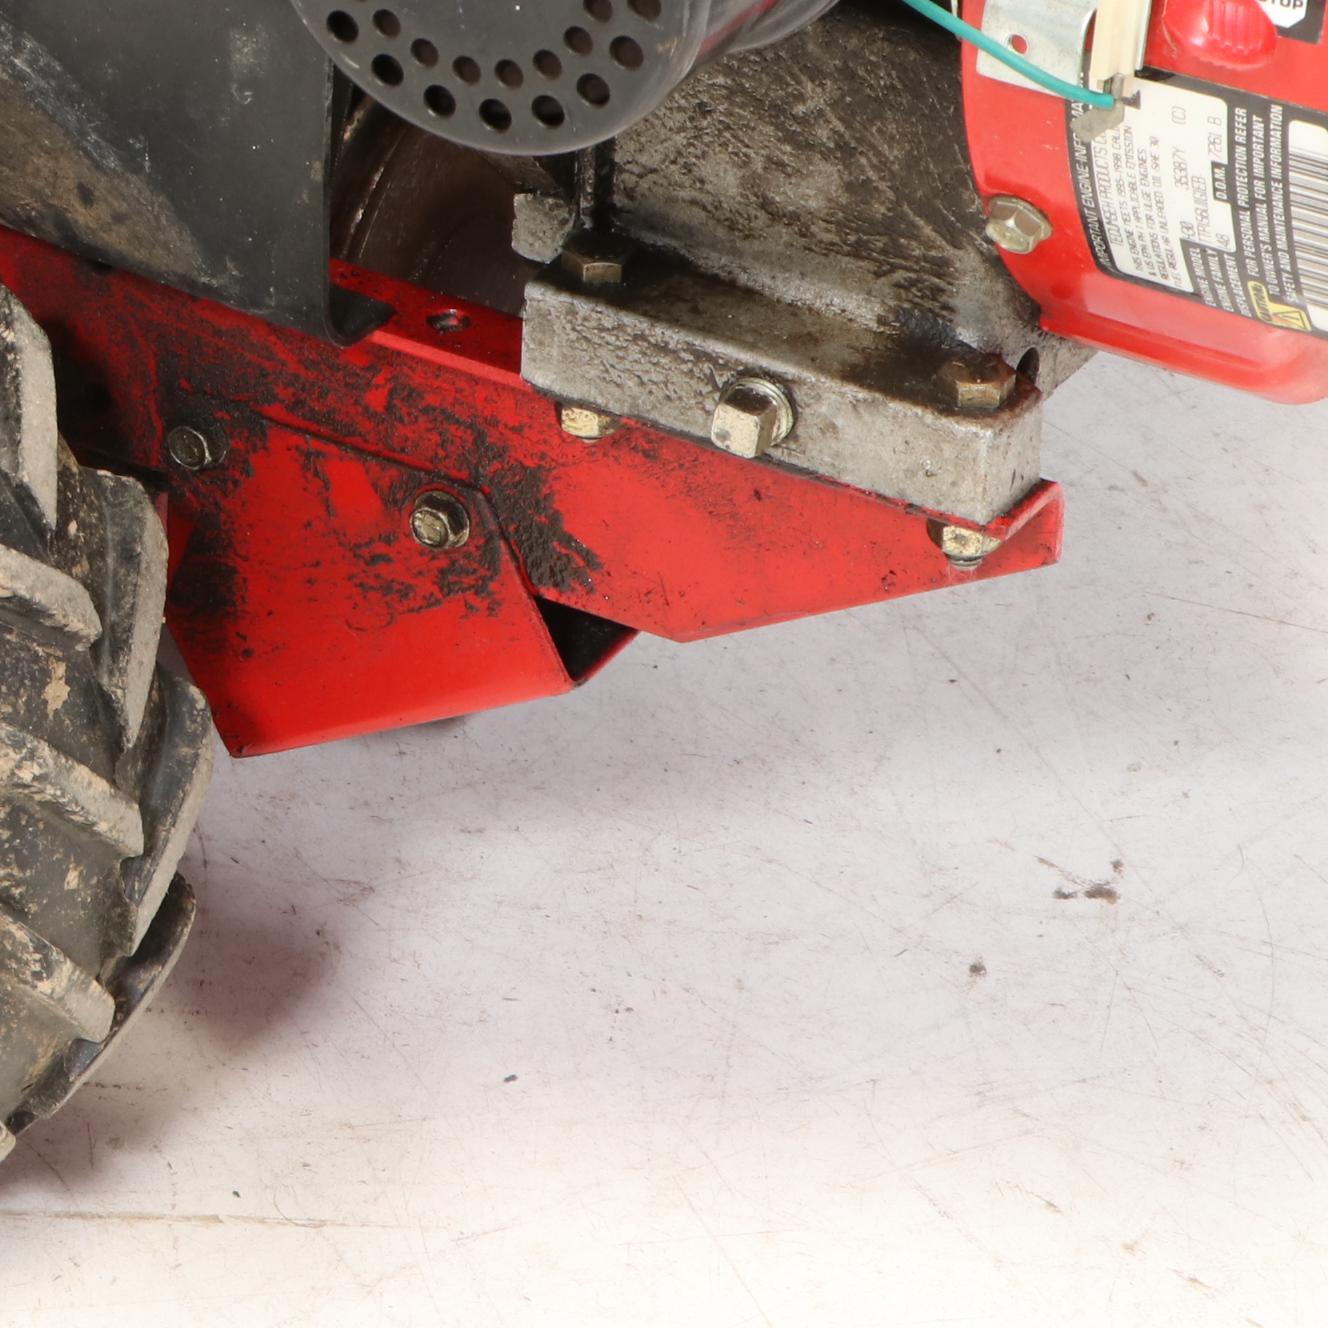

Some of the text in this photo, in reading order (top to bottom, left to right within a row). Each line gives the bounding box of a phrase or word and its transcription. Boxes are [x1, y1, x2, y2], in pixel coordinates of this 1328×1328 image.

[1252, 115, 1264, 178] IMPORTANT
[1270, 104, 1283, 179] INFORMATION
[1076, 164, 1095, 208] ENGINE
[1092, 144, 1114, 200] PRODUCTS
[1214, 167, 1227, 200] D.O.M.
[1235, 107, 1259, 277] FOR PERSONAL PROTECTION REFER
[1253, 179, 1266, 200] FOR
[1255, 203, 1270, 243] MANUAL
[1271, 181, 1288, 250] MAINTENANCE
[1189, 248, 1206, 277] MODEL
[1206, 248, 1224, 283] FAMILY
[1260, 243, 1278, 284] OWNER'S
[1278, 251, 1291, 272] AND
